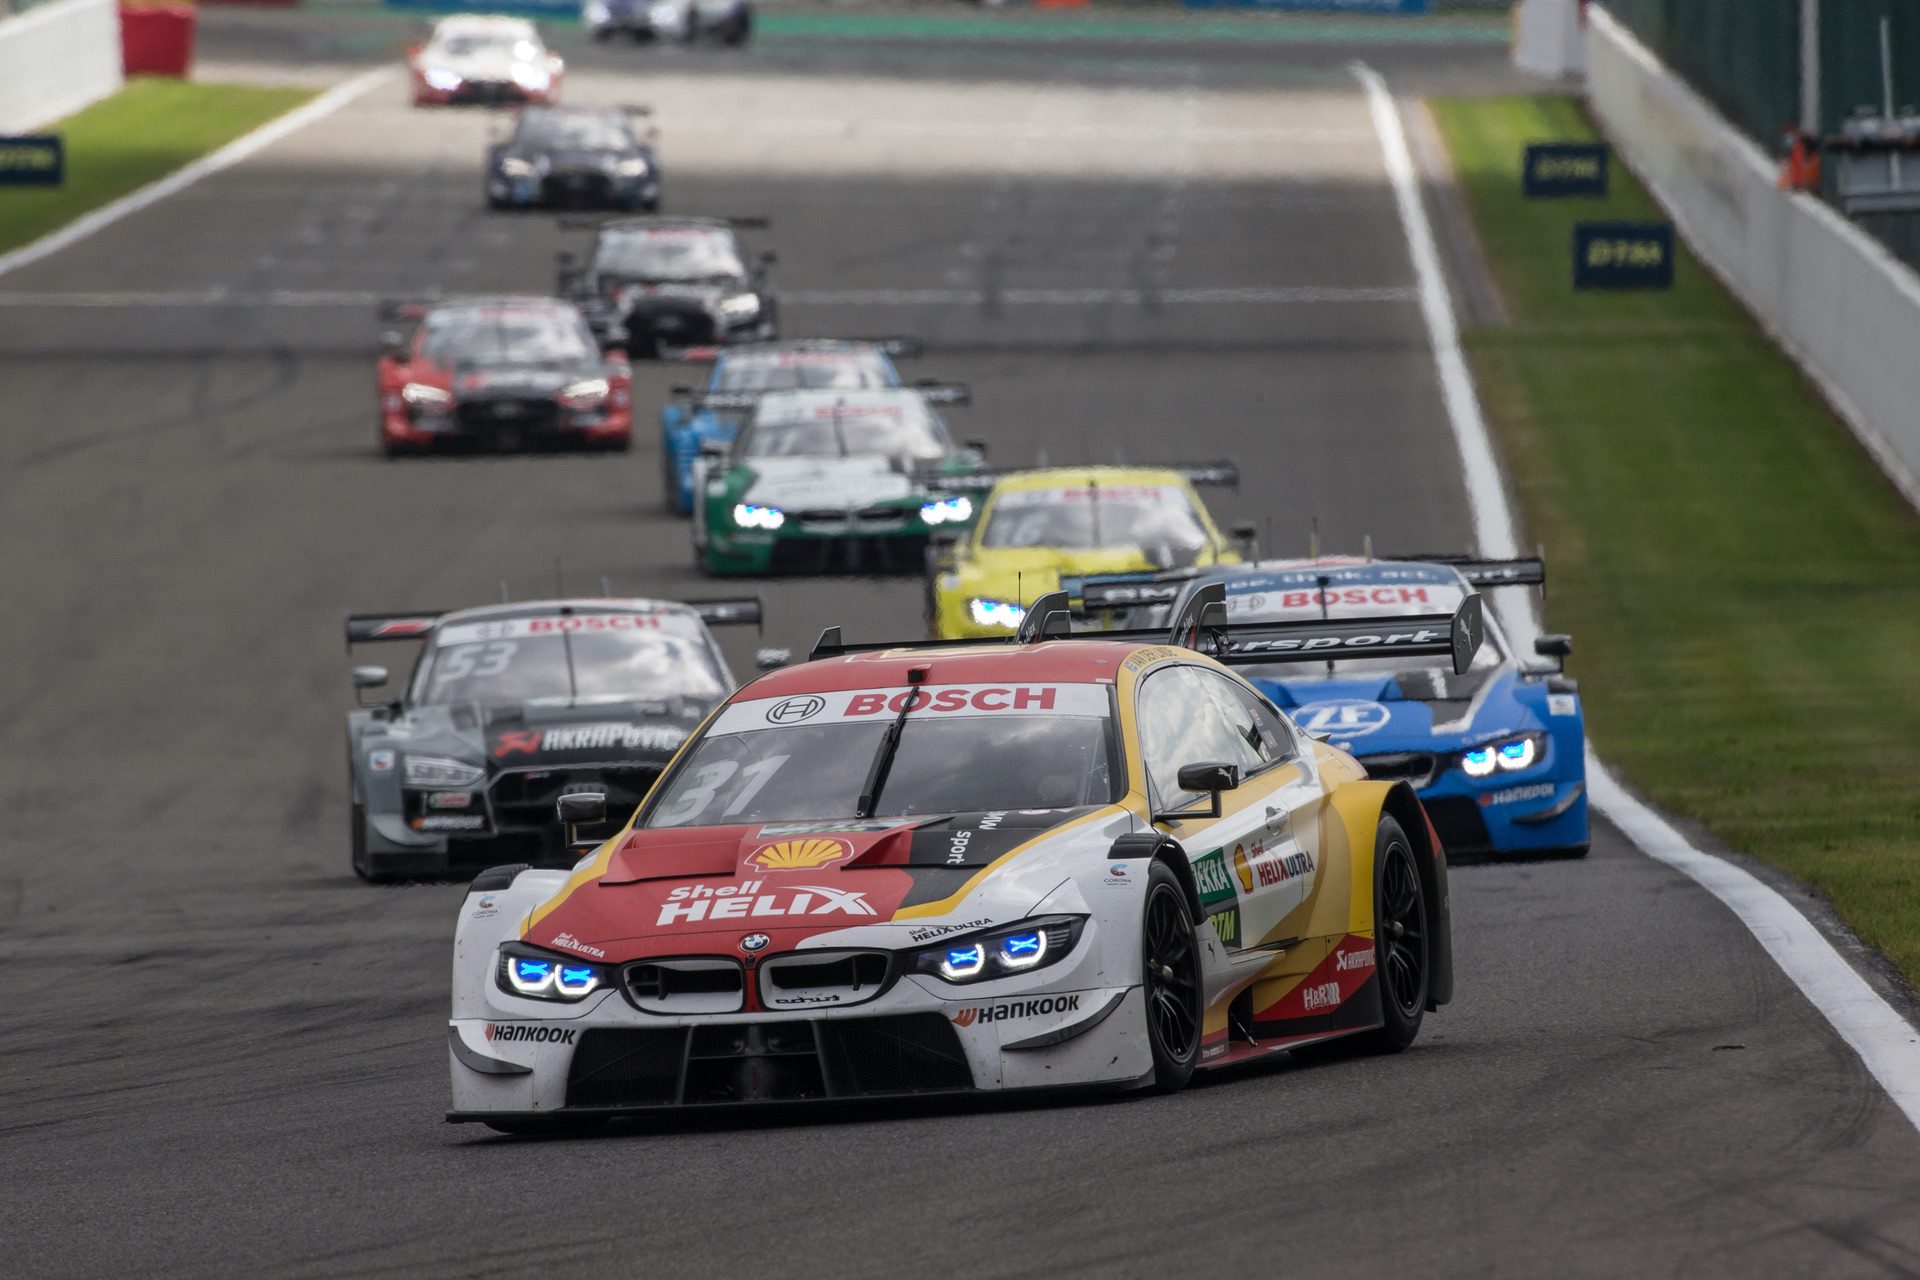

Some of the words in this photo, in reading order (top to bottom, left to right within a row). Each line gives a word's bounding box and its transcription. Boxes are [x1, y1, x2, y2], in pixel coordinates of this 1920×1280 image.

[1282, 587, 1428, 609] BOSCH
[529, 614, 661, 634] BOSCH
[439, 641, 519, 682] 53
[843, 687, 1057, 717] BOSCH
[1305, 708, 1369, 733] ZF
[650, 753, 791, 828] 31
[979, 811, 1008, 830] MW
[947, 830, 972, 864] sport
[1256, 857, 1289, 888] HELIX
[1285, 850, 1315, 878] ULTRA
[667, 879, 763, 901] Shell
[655, 885, 878, 926] HELIX
[912, 925, 954, 943] HELIX
[954, 917, 994, 932] ULTRA
[577, 944, 606, 958] ULTRA
